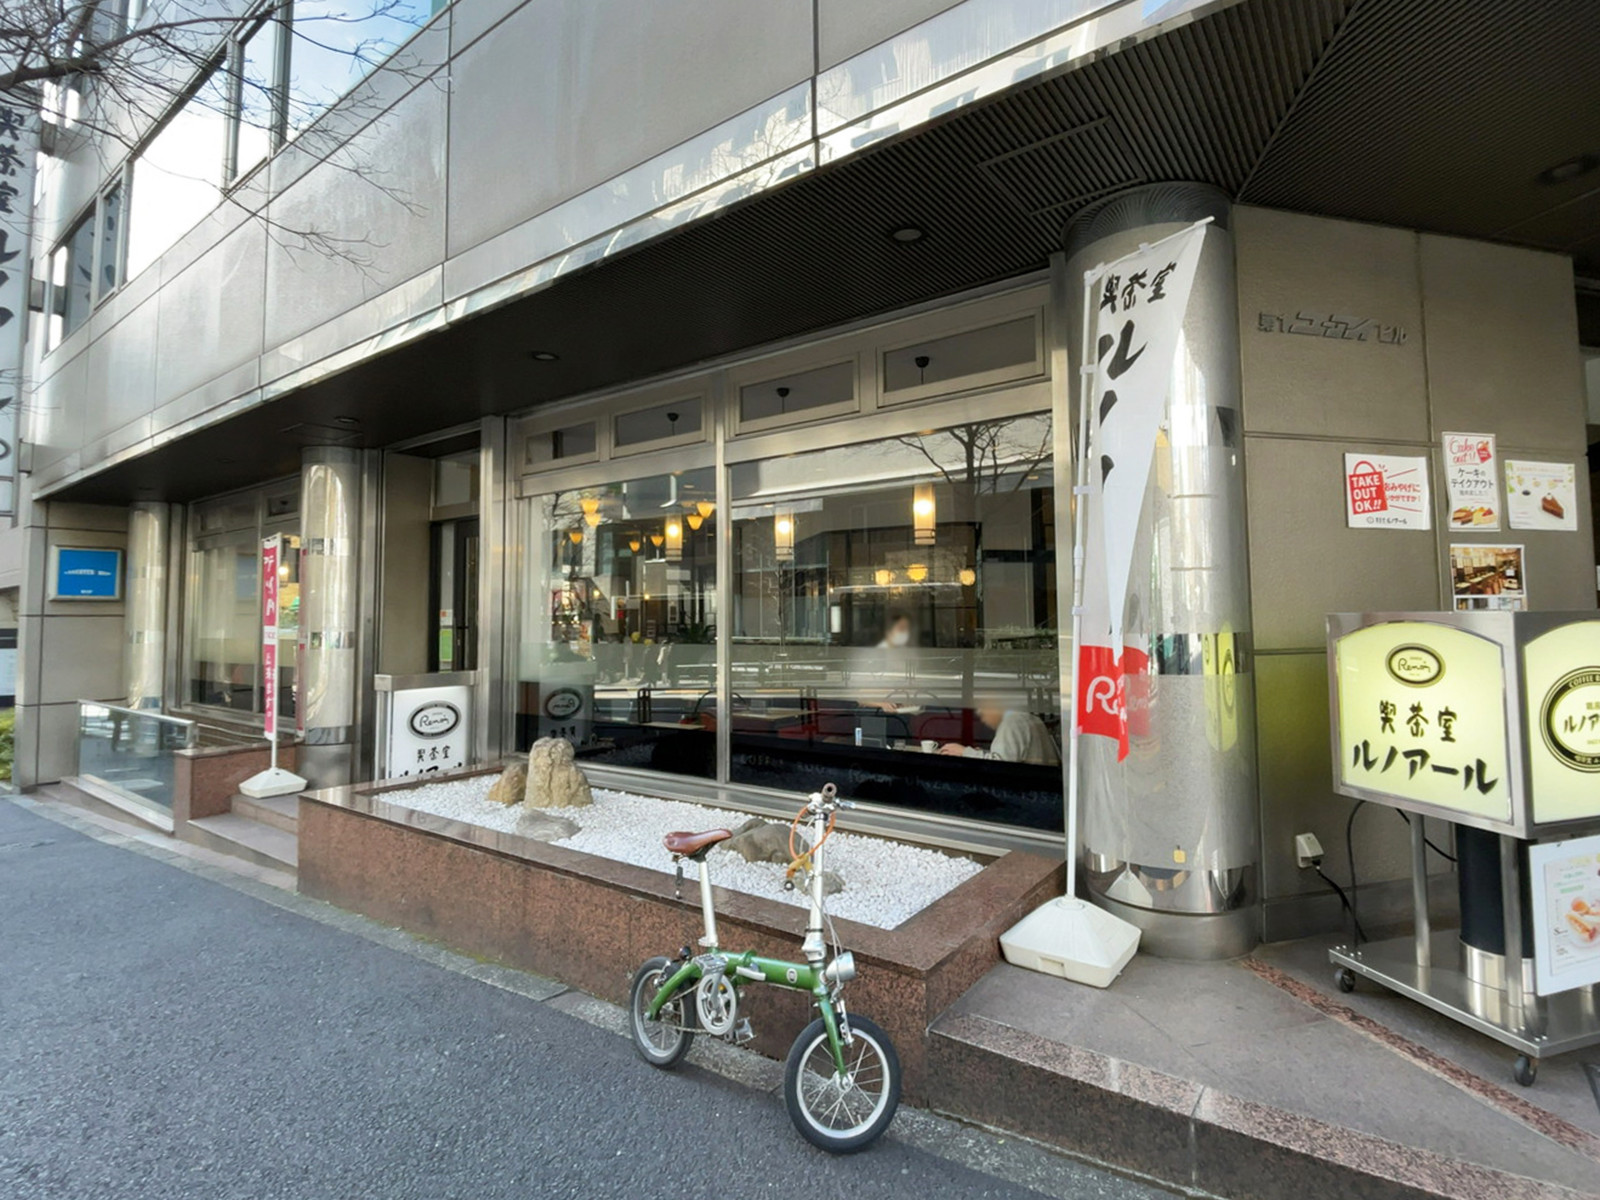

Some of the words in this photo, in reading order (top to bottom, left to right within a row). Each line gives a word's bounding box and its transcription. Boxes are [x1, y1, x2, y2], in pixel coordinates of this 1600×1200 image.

[1351, 474, 1381, 488] TAKE
[1451, 478, 1494, 489] テイクアウト
[1353, 487, 1377, 500] OUT
[1355, 499, 1381, 512] OK!!
[1379, 700, 1457, 743] 喫茶室
[417, 745, 452, 764] 喫茶室
[1352, 739, 1499, 796] ルノアール
